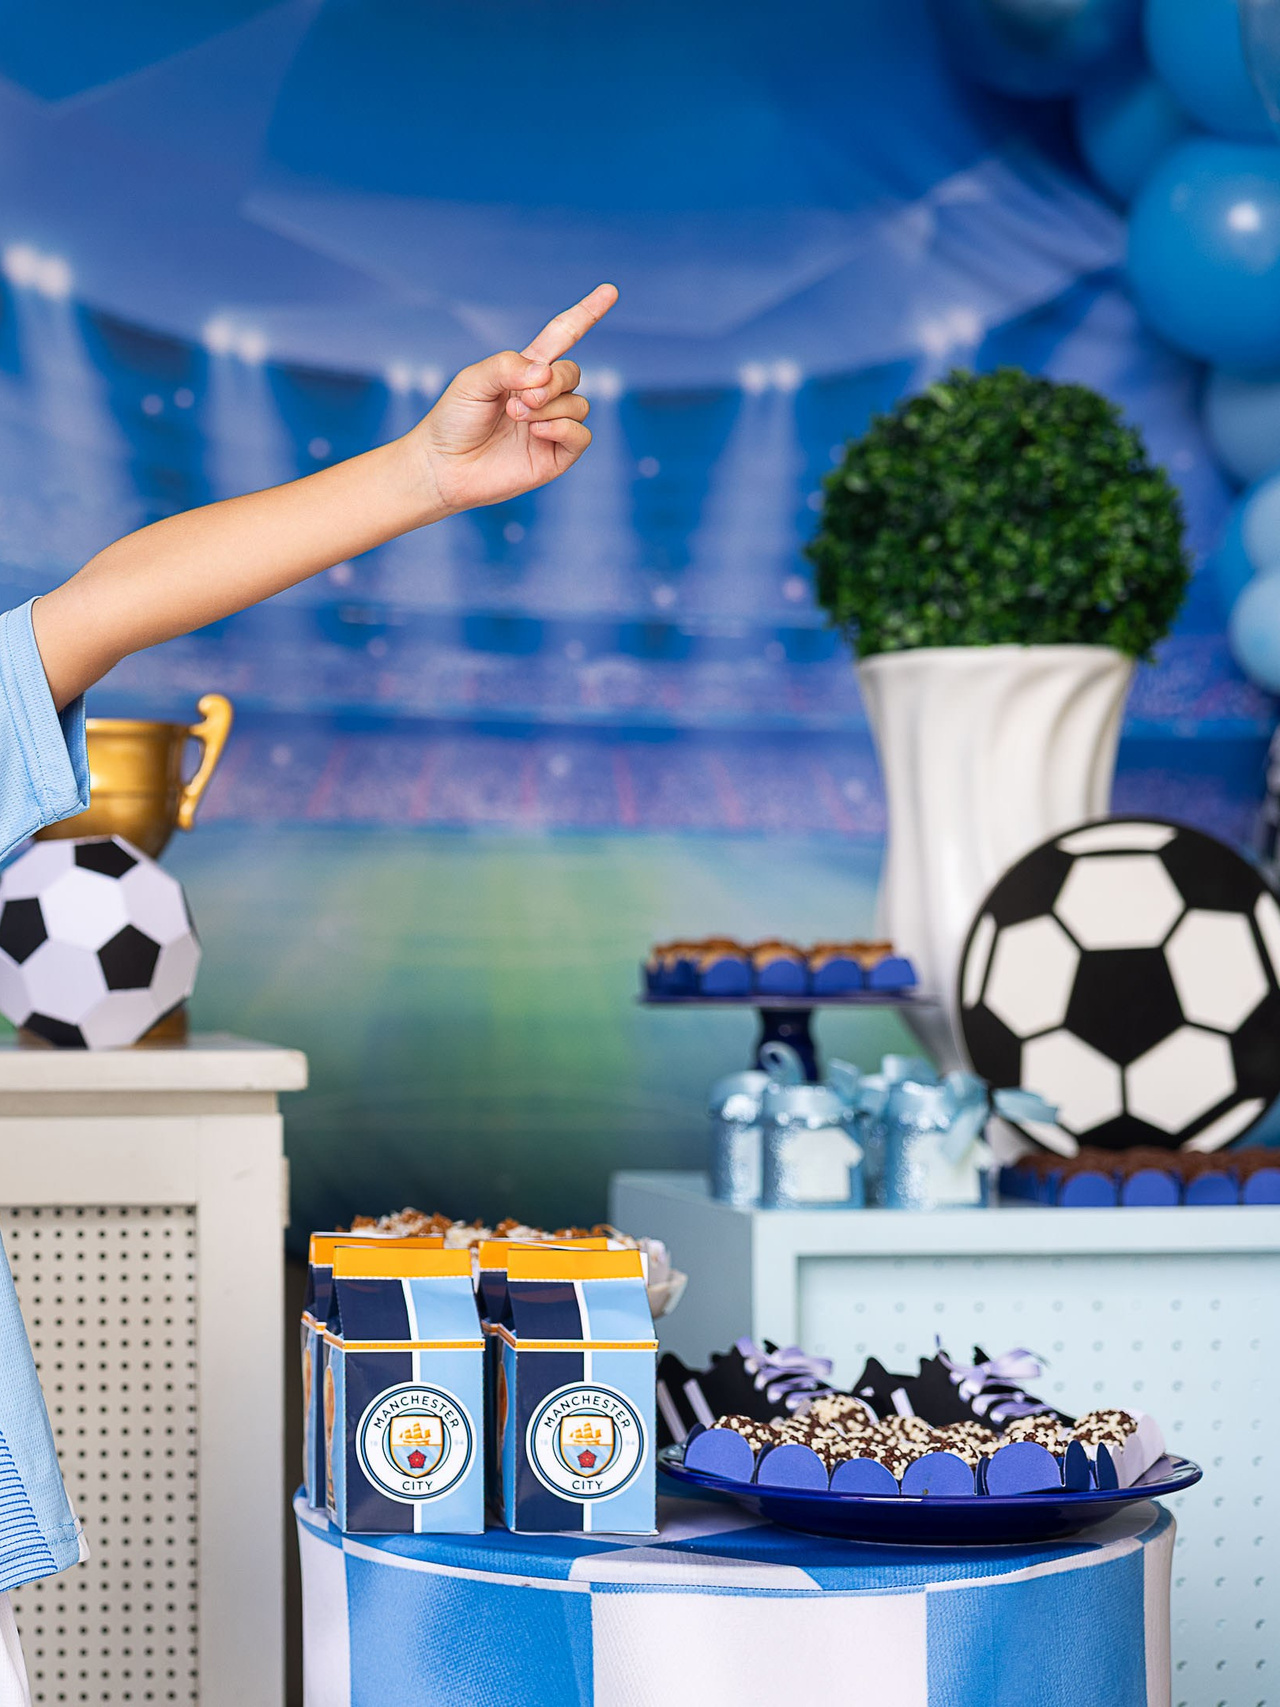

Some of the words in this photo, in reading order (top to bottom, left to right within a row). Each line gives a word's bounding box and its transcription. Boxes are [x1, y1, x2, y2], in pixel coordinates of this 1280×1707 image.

[373, 1394, 460, 1429] MANCHESTER
[543, 1394, 631, 1429] MANCHESTER
[402, 1480, 433, 1491] CITY
[572, 1480, 603, 1490] CITY
